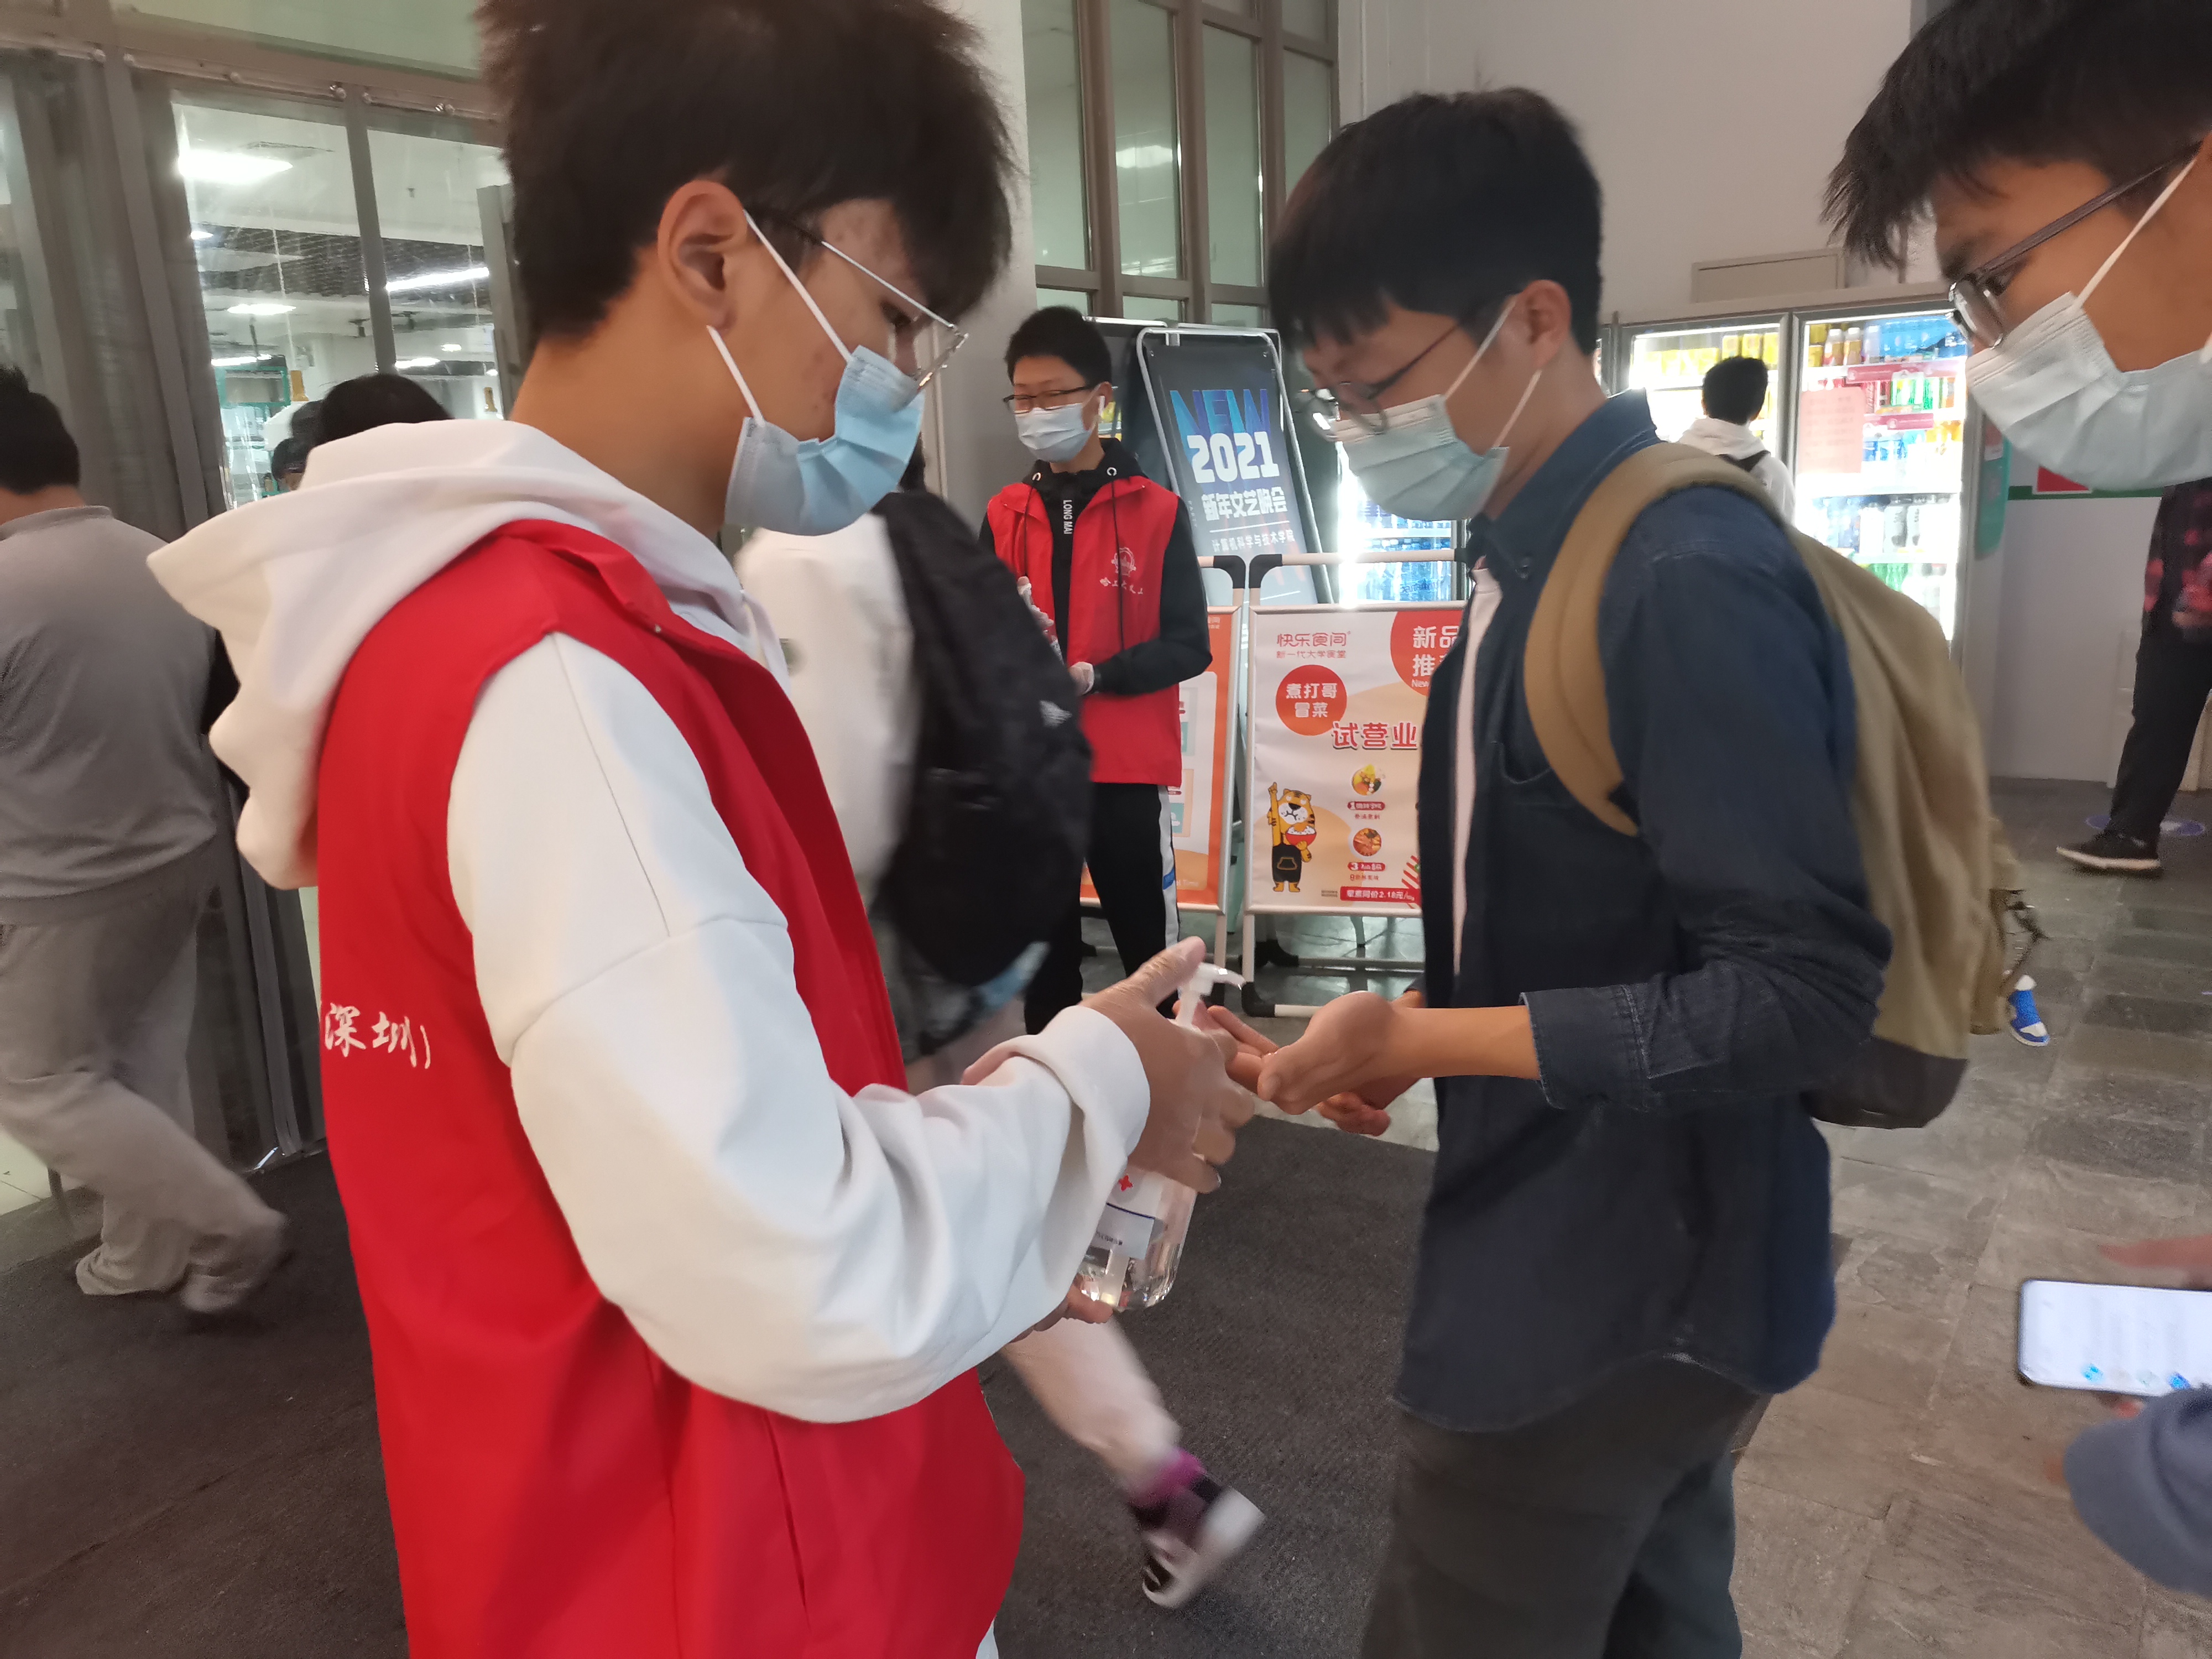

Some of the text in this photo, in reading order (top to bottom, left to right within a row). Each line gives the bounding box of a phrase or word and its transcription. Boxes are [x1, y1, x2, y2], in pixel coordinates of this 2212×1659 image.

[1169, 388, 1272, 445] NEW
[1187, 431, 1280, 483] 2021
[1063, 499, 1073, 520] LONG
[1201, 486, 1288, 521] 新年文艺晚会
[1412, 625, 1459, 648] 新品
[1412, 654, 1448, 677] 推
[1286, 683, 1337, 699] 煮打哥
[1295, 702, 1328, 718] 冒菜
[1333, 721, 1417, 750] 试营业
[325, 1002, 431, 1070] 深圳
